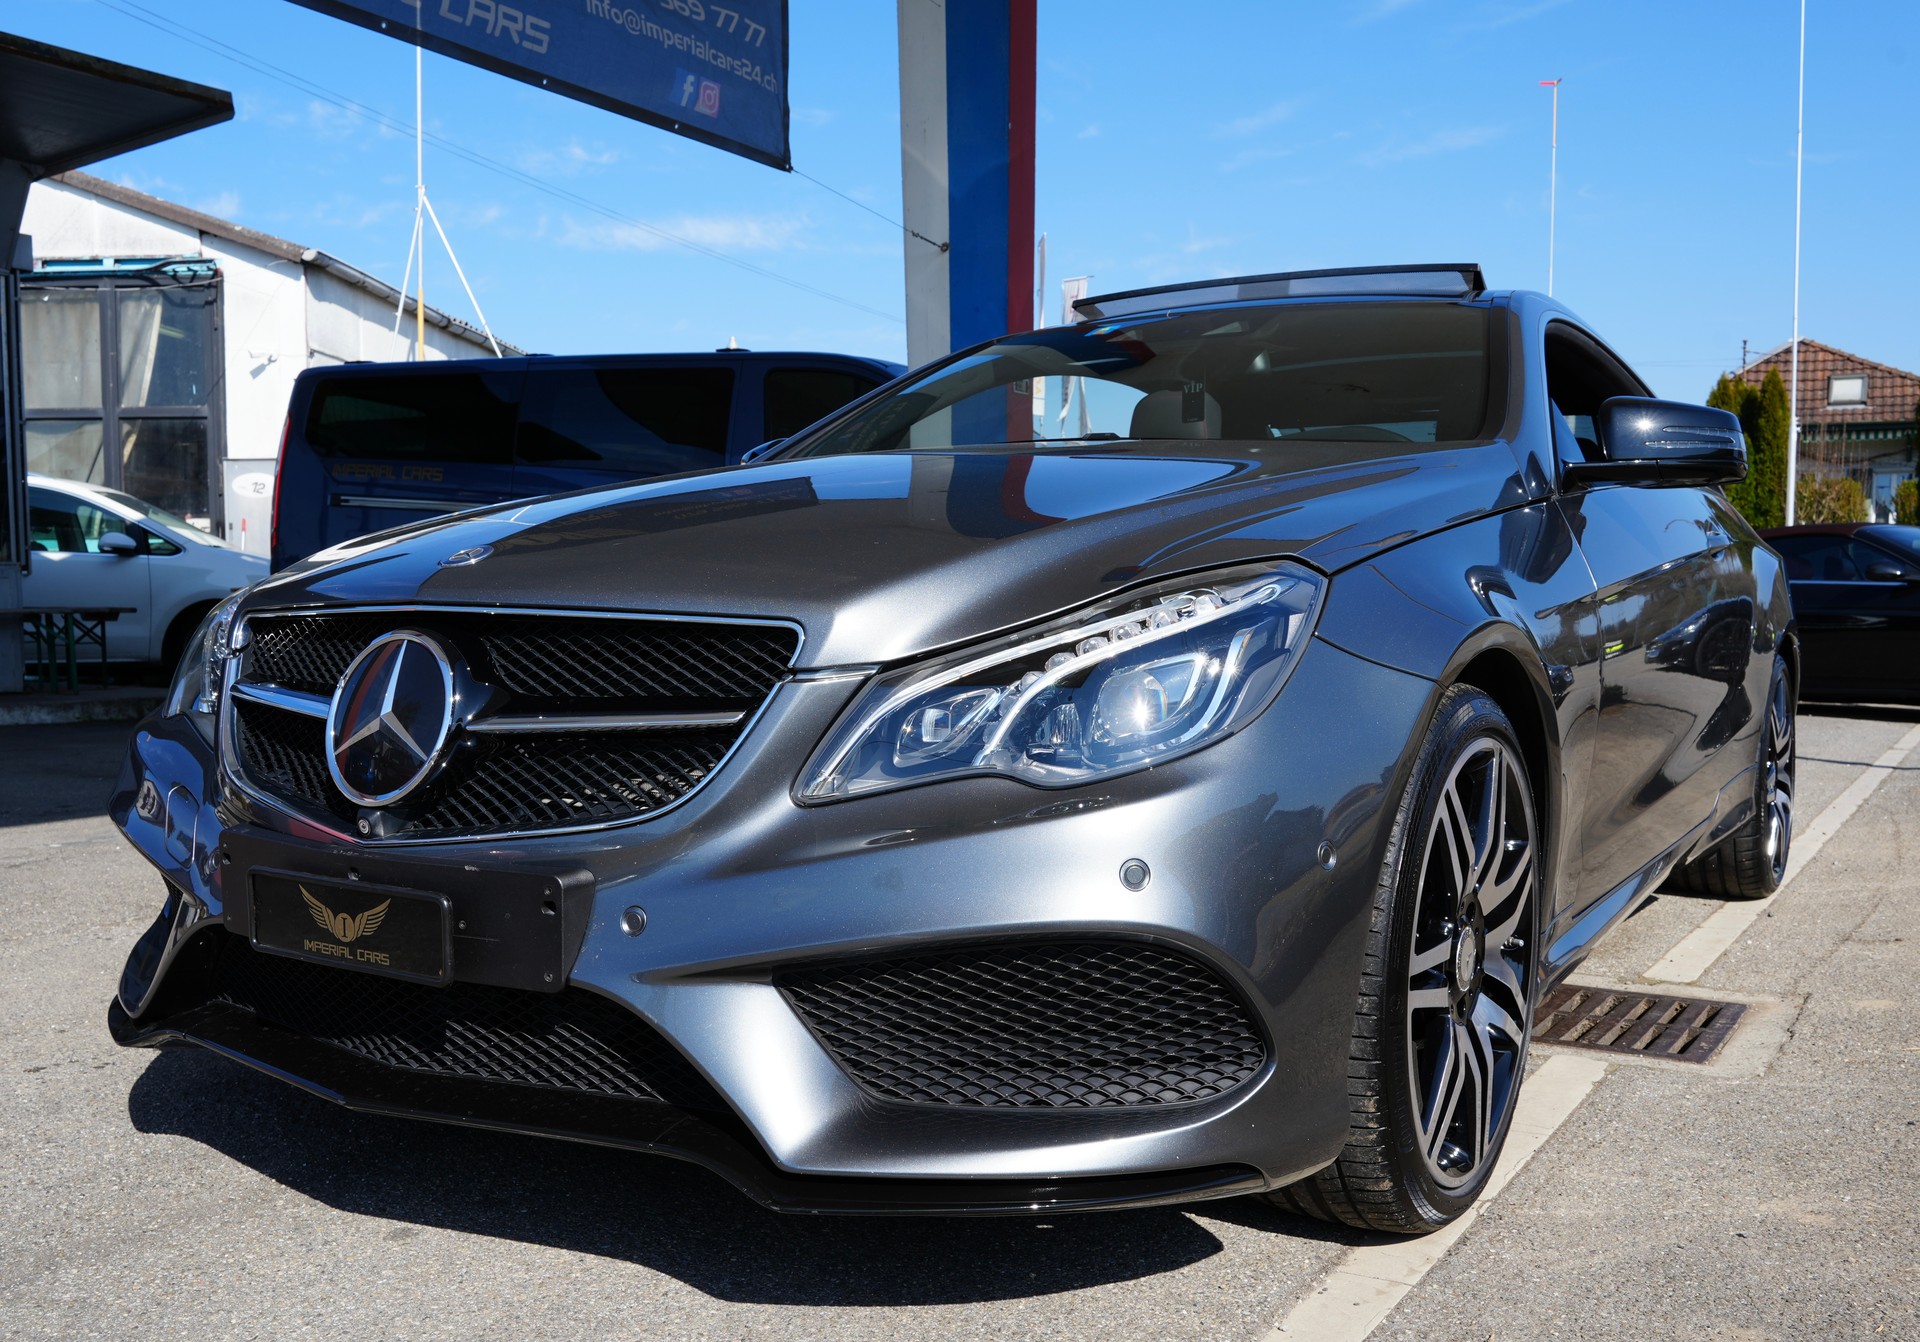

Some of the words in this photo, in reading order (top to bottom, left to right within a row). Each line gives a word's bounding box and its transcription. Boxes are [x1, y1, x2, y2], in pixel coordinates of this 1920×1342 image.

[711, 5, 739, 33] 77
[744, 18, 766, 47] 77
[331, 463, 396, 479] IMPERIAL
[402, 465, 444, 482] CARS
[251, 481, 266, 495] 12
[303, 939, 354, 959] IMPERIAL
[356, 948, 390, 966] CARS
